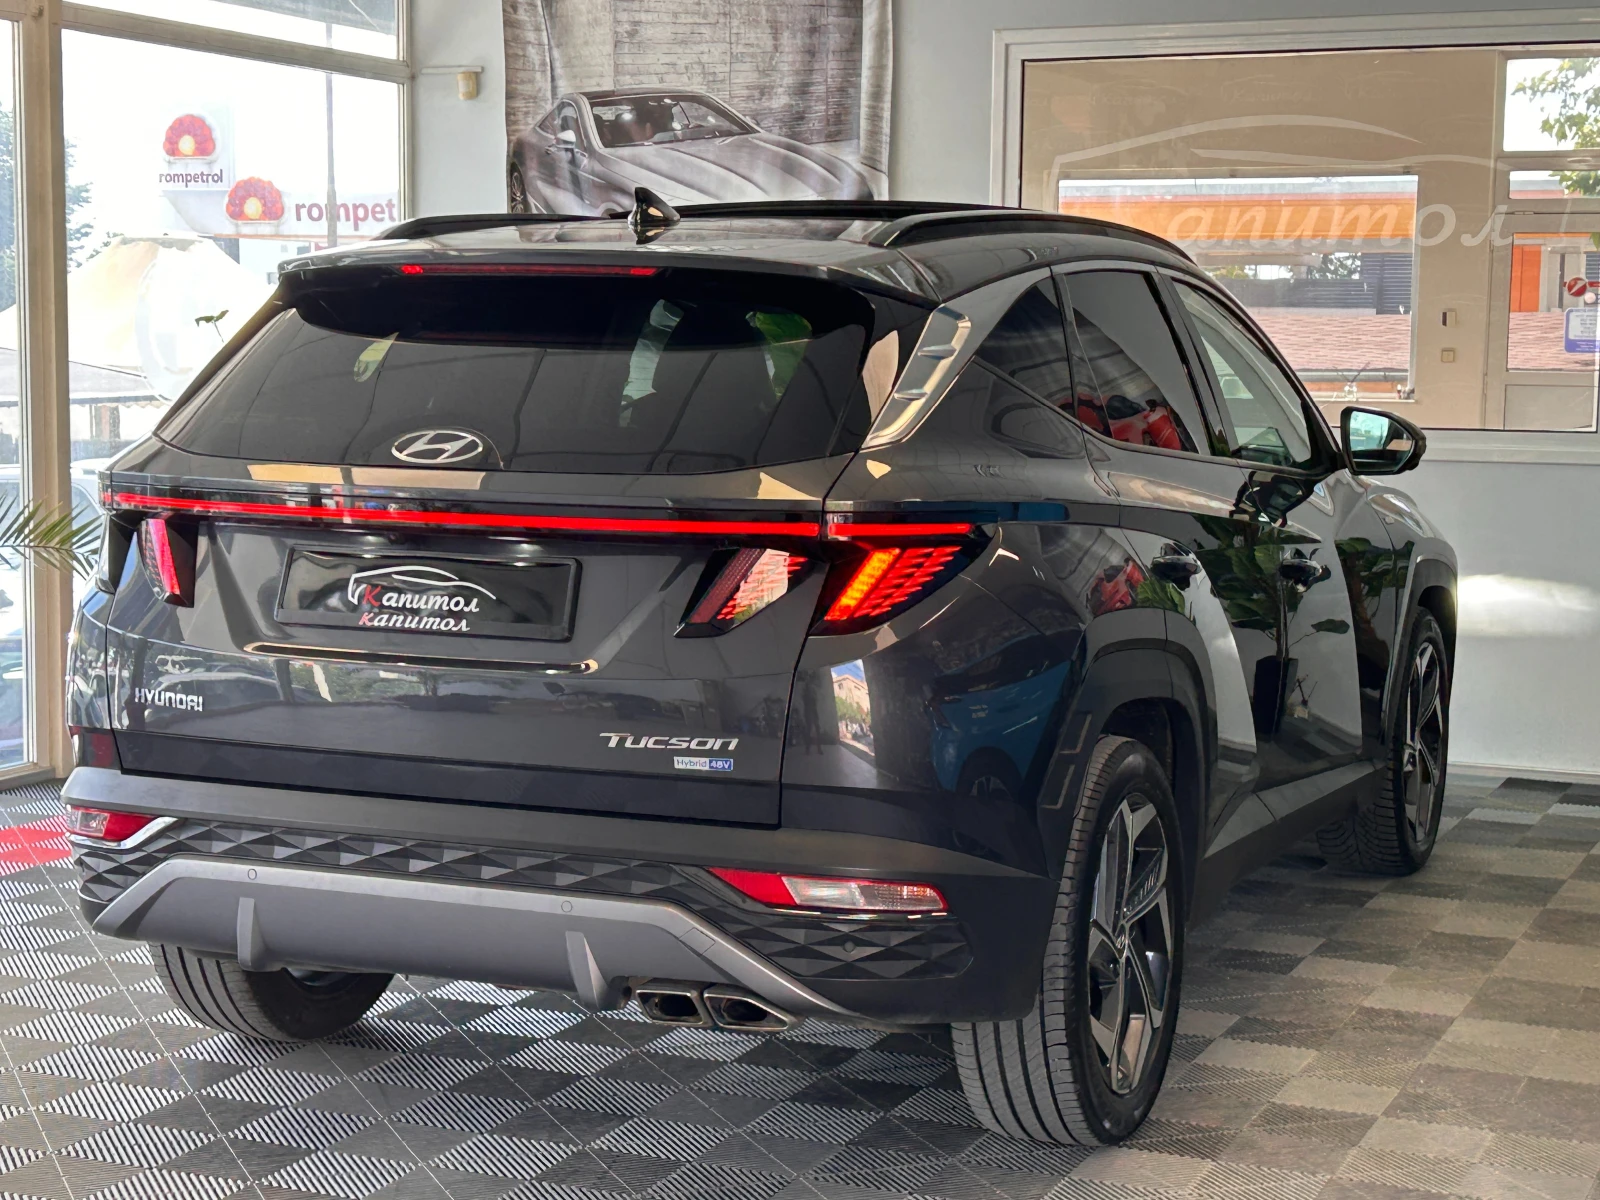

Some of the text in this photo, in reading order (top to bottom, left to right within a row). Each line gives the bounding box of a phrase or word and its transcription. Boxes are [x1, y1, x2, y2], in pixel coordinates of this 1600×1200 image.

[159, 169, 223, 188] rompetrol
[134, 687, 203, 712] HYUNDAI
[676, 759, 731, 769] Hybrid 48V
